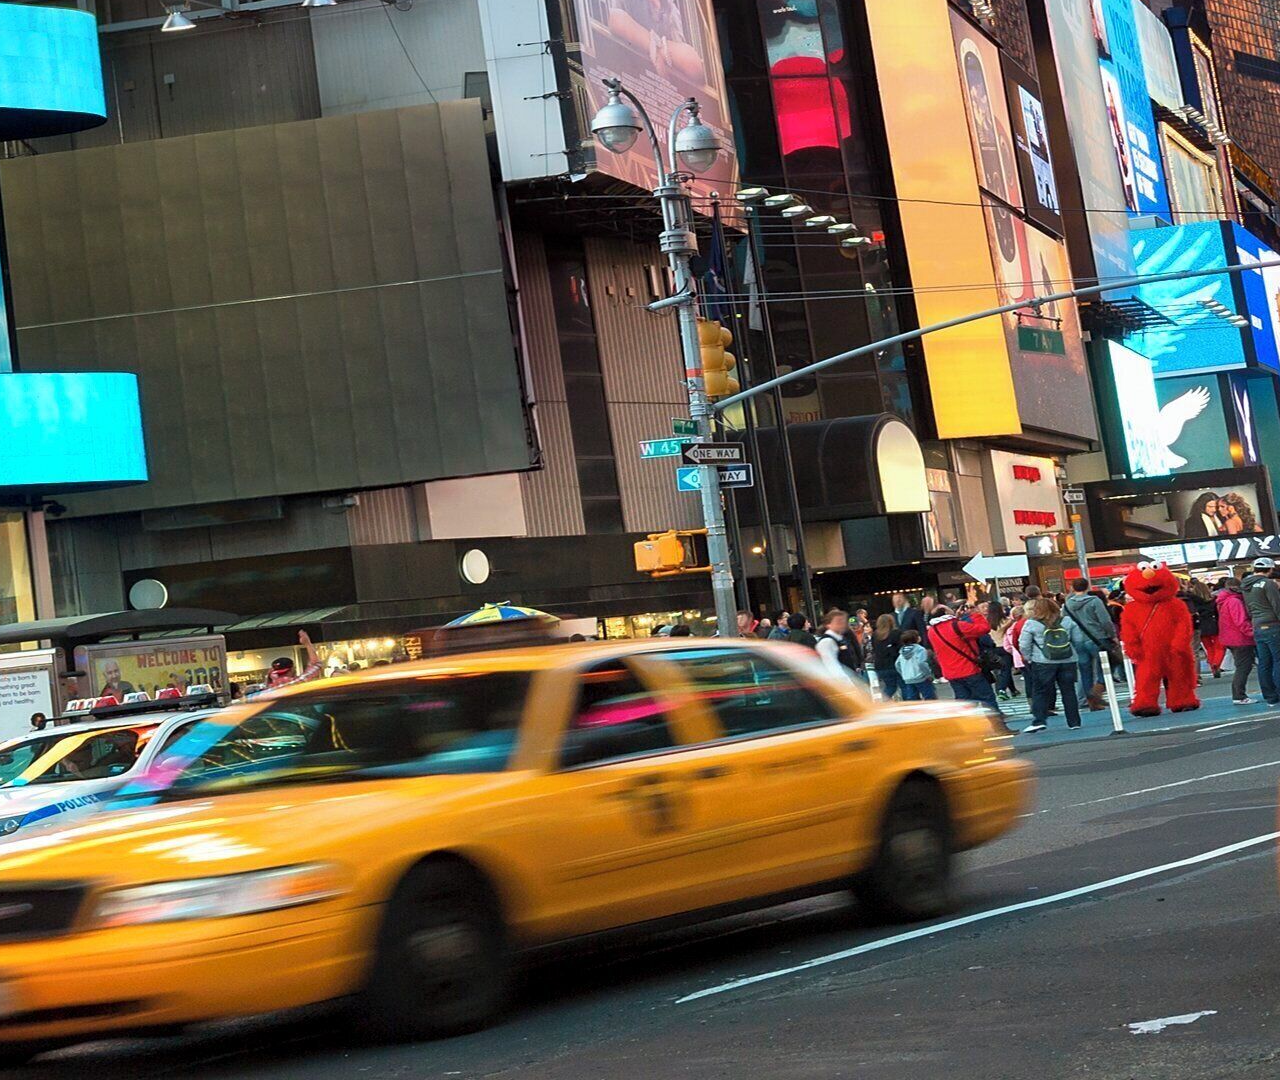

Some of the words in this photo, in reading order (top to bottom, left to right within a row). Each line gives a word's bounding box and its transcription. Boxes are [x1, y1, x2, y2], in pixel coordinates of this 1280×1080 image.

[640, 443, 655, 456] W
[661, 441, 679, 454] 45
[692, 449, 713, 459] ONE
[716, 449, 737, 458] WAY
[719, 471, 742, 482] WAY
[137, 648, 197, 668] WELCOME
[201, 645, 220, 662] TO
[57, 793, 99, 813] POLICE
